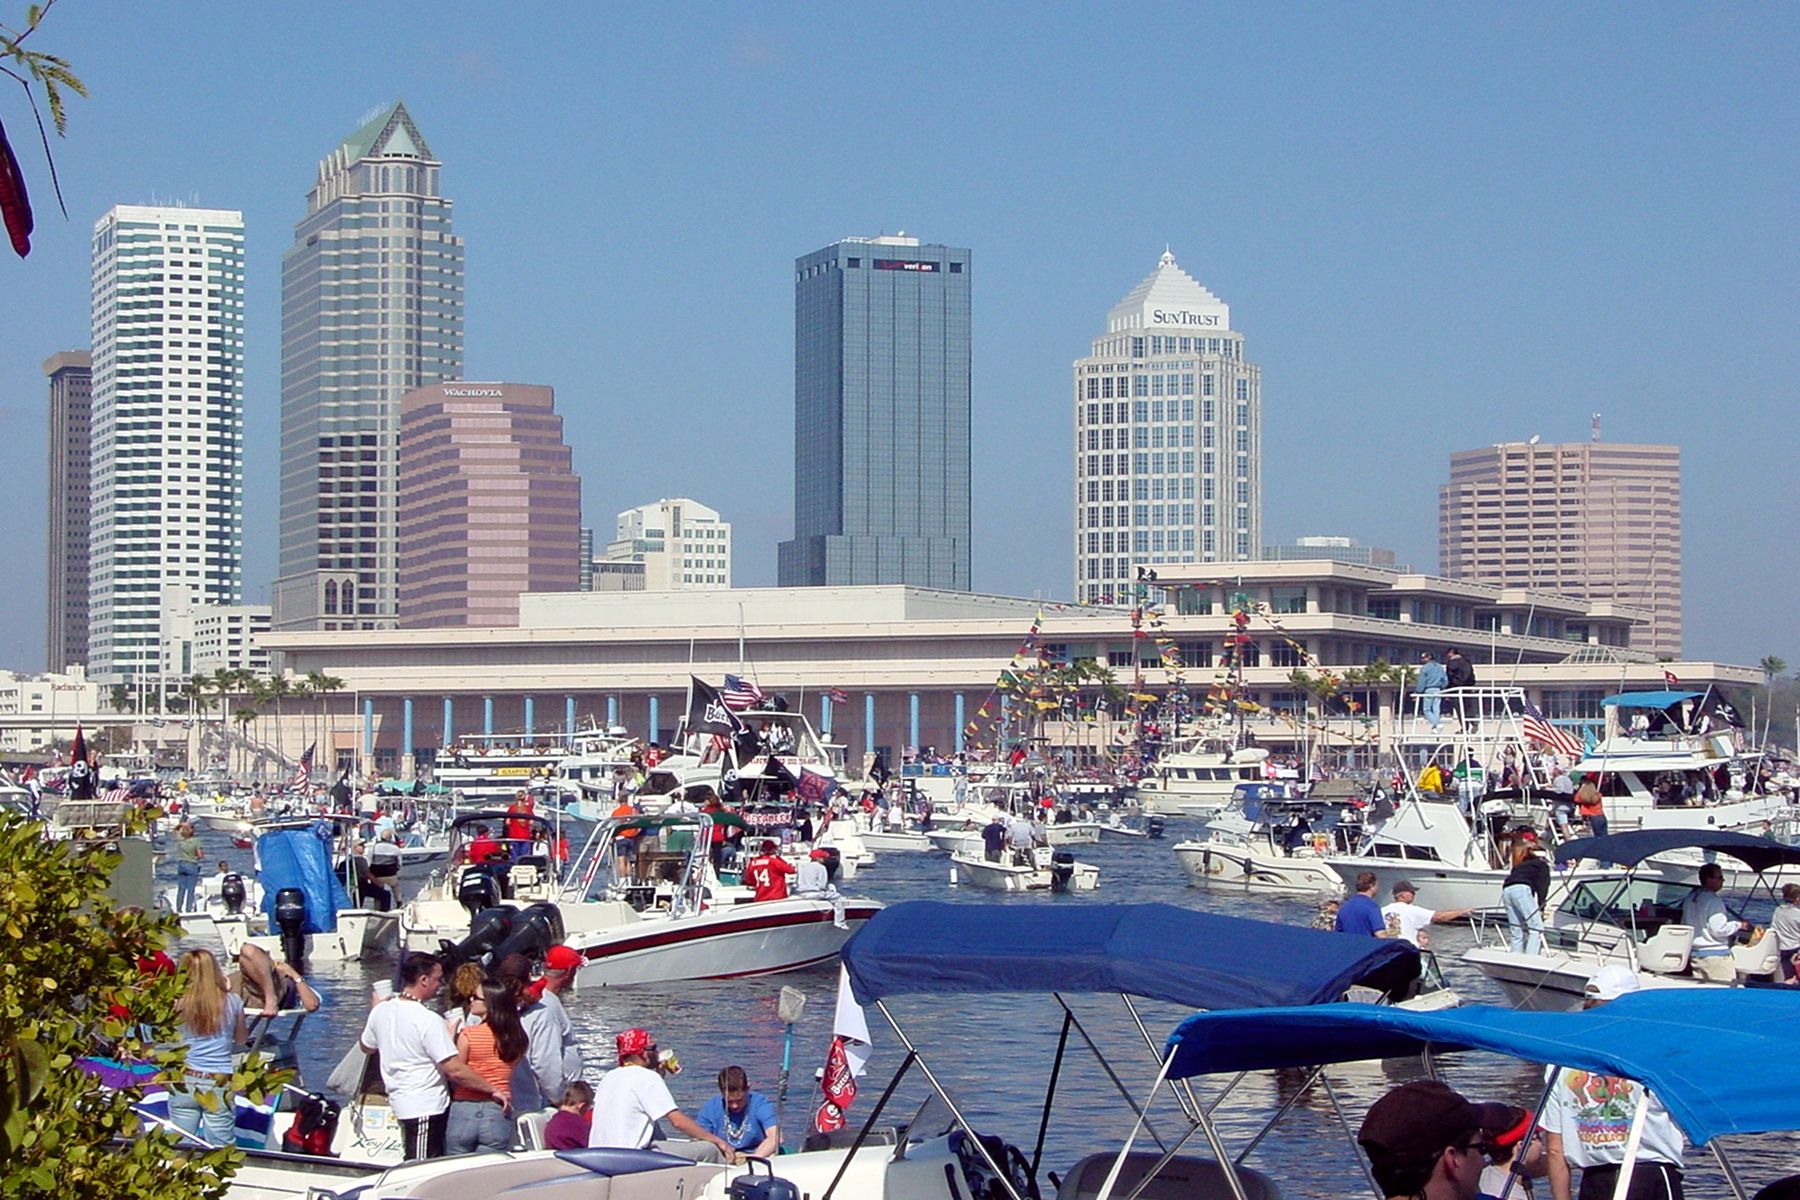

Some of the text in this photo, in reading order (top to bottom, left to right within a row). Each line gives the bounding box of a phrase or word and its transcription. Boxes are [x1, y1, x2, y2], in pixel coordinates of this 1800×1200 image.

[903, 262, 933, 271] verion
[443, 388, 503, 397] WACHOVIA
[753, 868, 771, 887] 14
